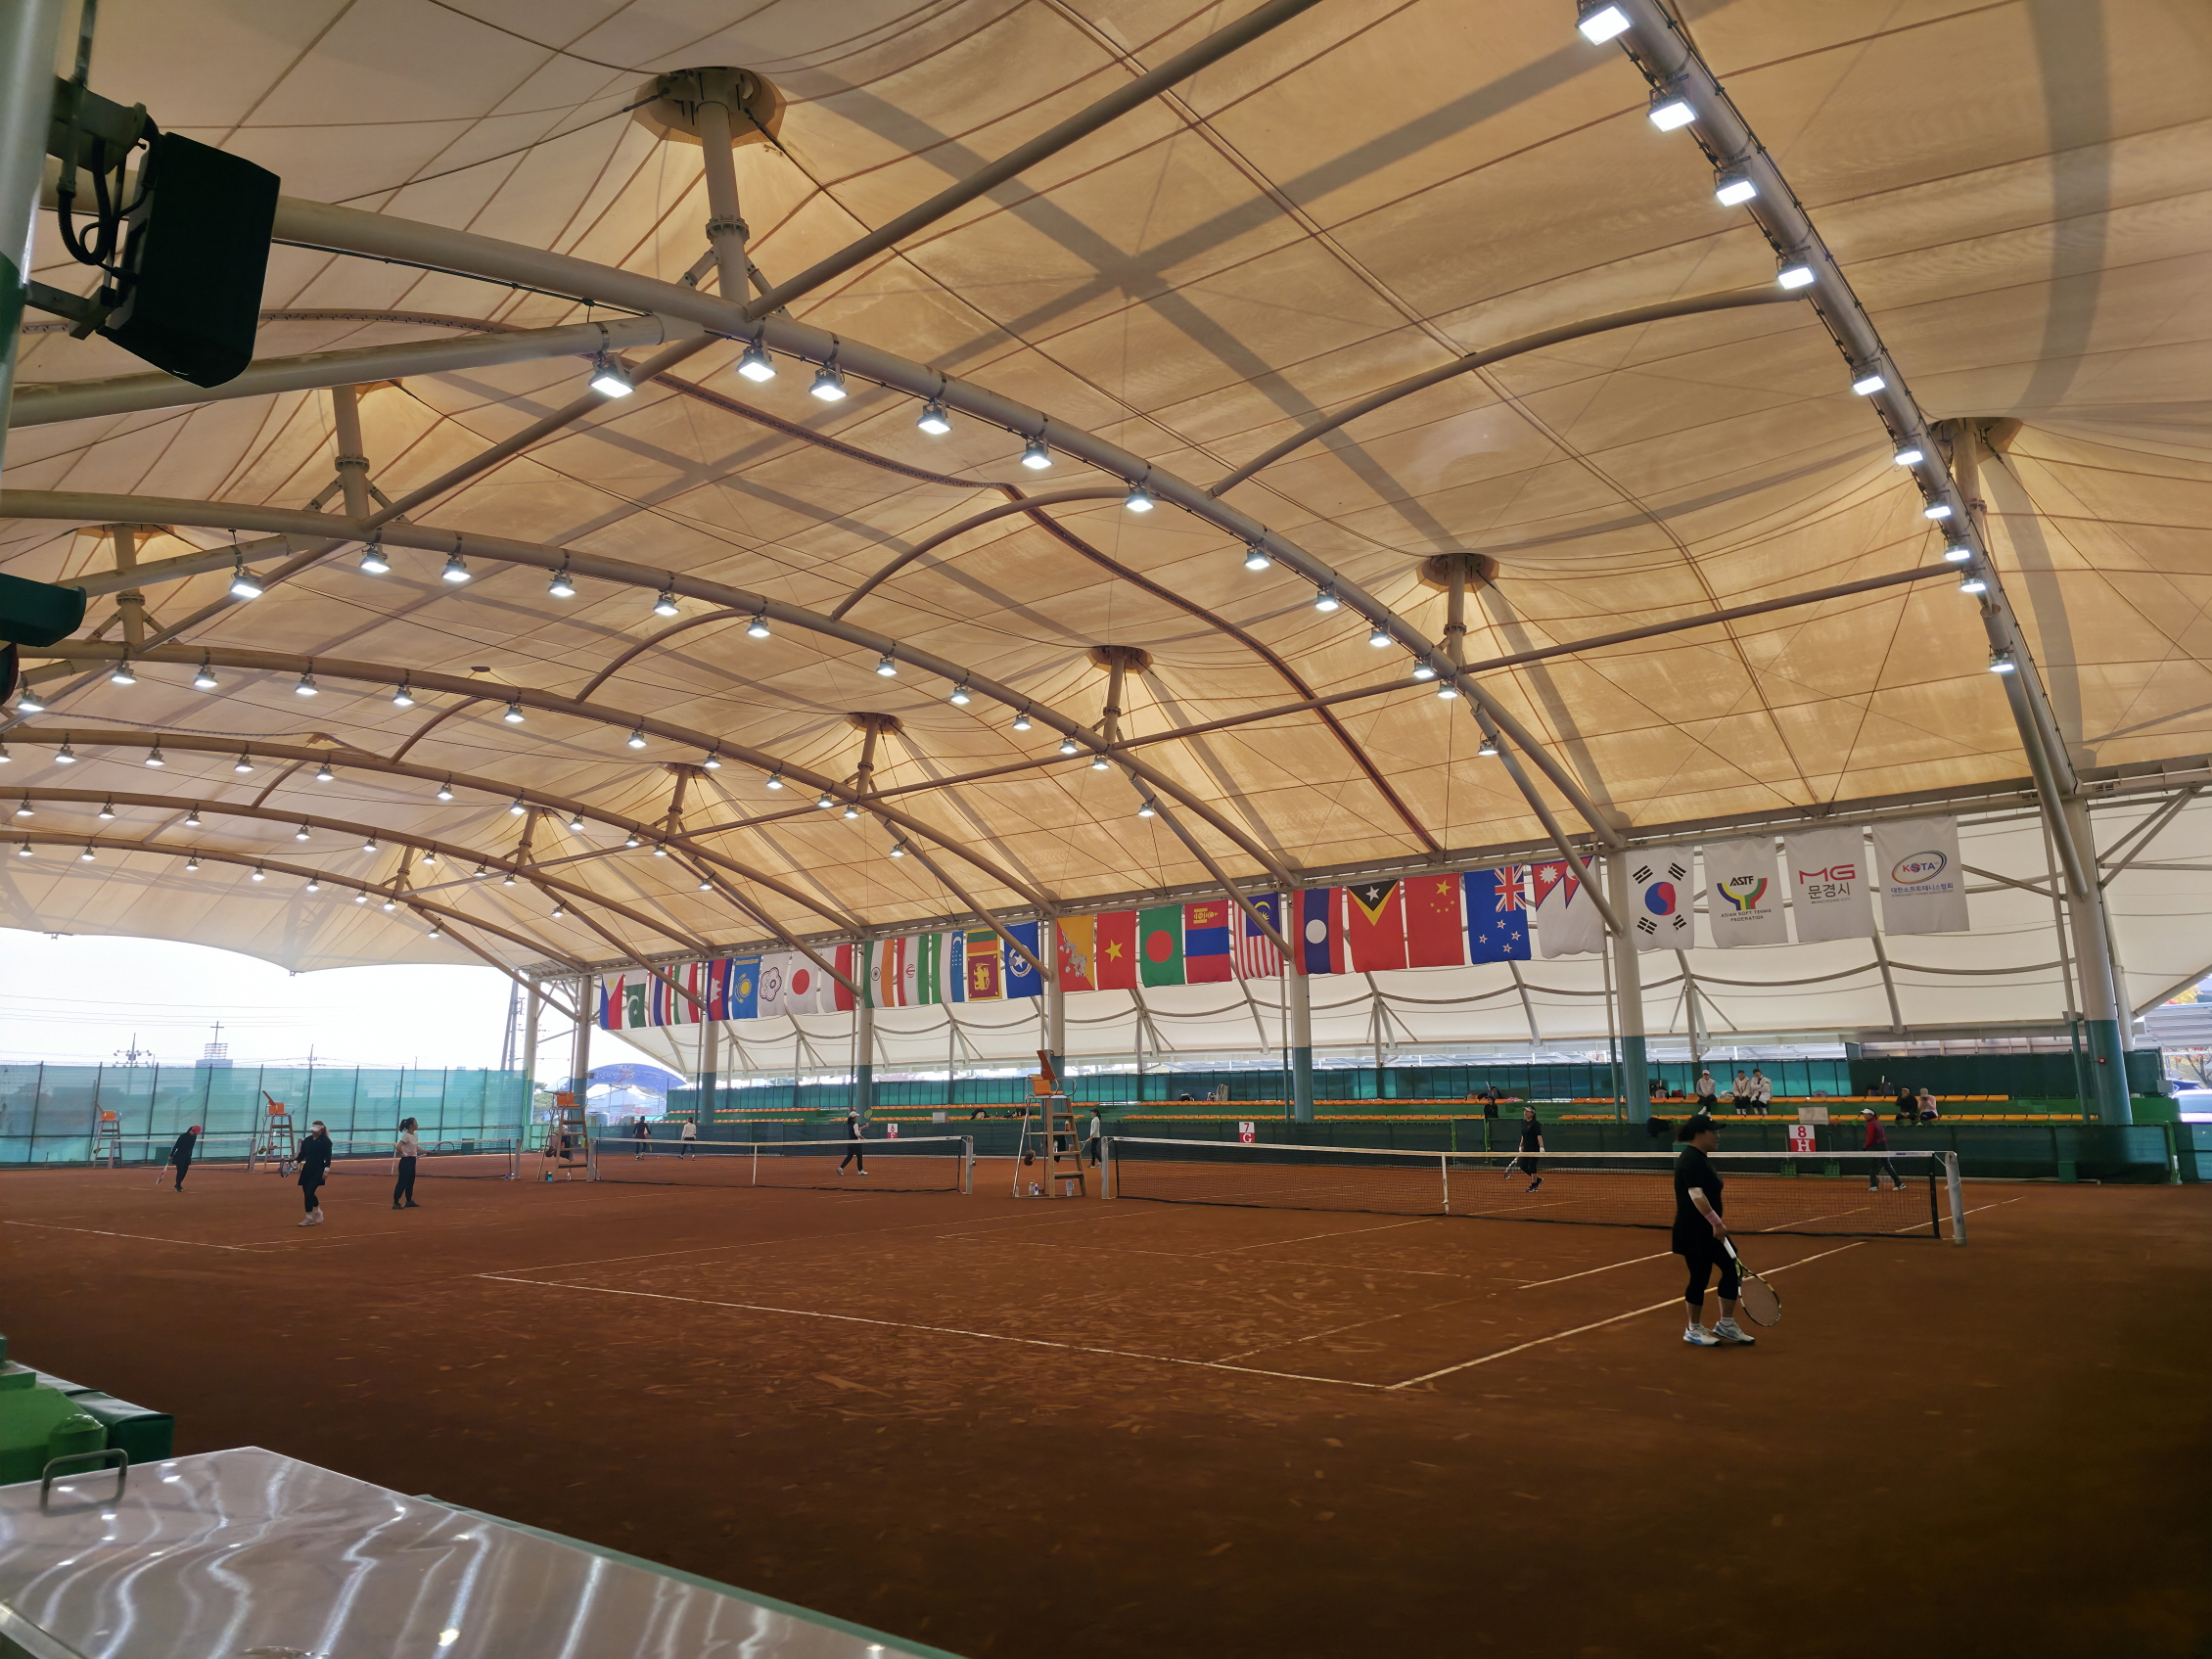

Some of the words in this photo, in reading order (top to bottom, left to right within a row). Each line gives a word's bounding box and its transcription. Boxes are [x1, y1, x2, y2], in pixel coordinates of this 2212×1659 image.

[1902, 862, 1936, 873] KSTA
[1799, 863, 1856, 885] MG
[1729, 875, 1754, 887] ASTF
[1808, 881, 1851, 899] 문경시
[890, 1124, 896, 1132] 6
[1243, 1122, 1250, 1132] 7
[1797, 1125, 1808, 1138] 8
[1242, 1132, 1253, 1143] G
[1796, 1139, 1812, 1152] H
